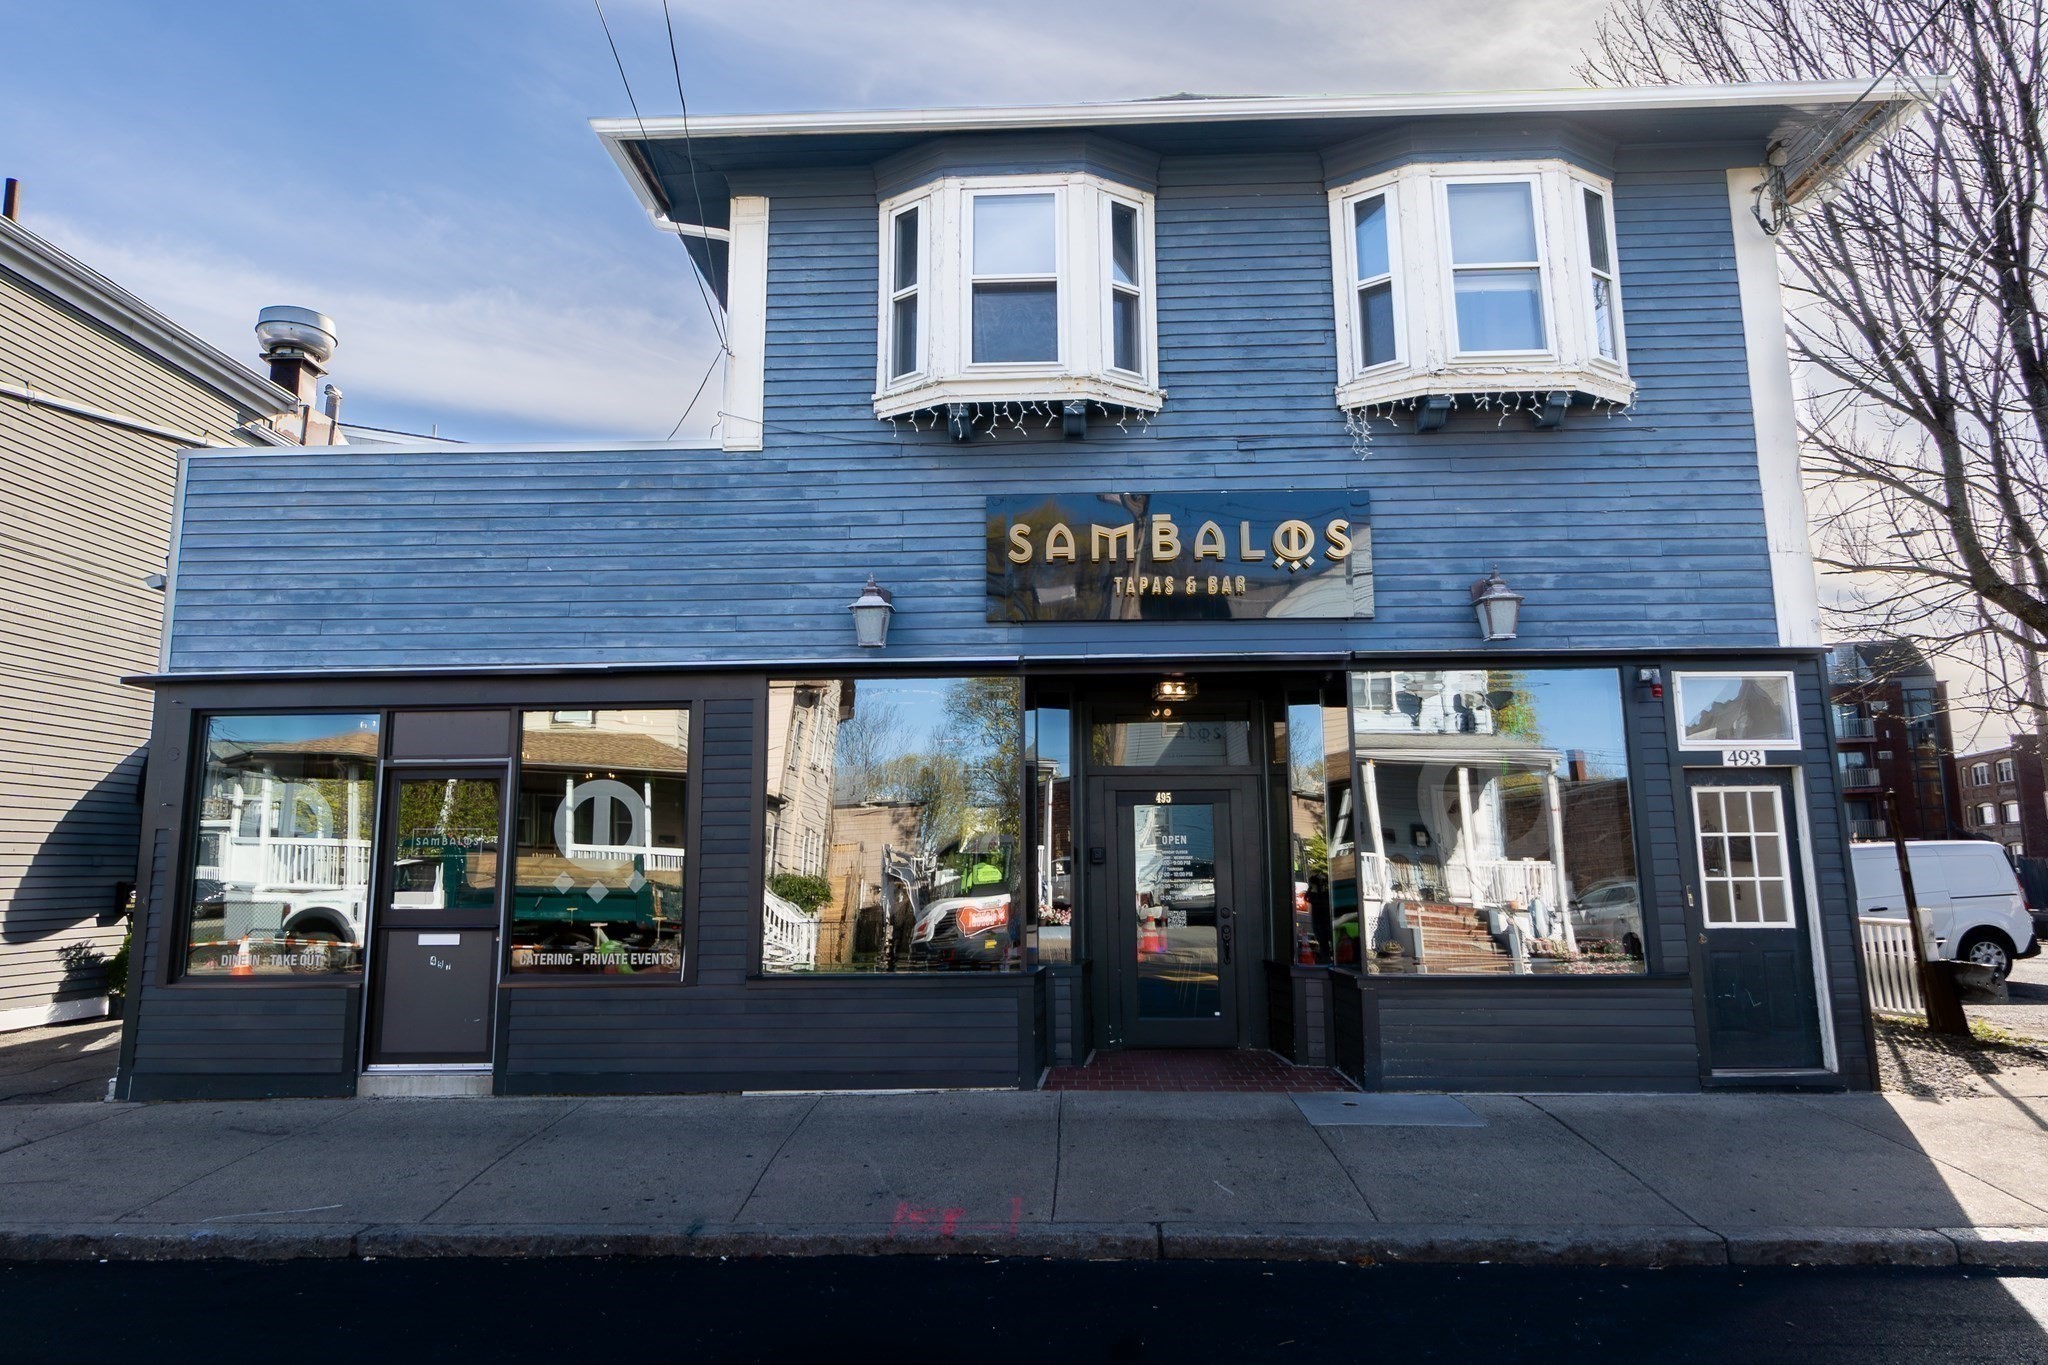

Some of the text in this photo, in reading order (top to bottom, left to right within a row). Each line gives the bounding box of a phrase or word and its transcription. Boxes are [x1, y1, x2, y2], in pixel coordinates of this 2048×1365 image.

[1114, 575, 1246, 596] TAPAS & BAR
[1727, 750, 1761, 766] 493
[1156, 792, 1172, 803] 495
[1162, 835, 1187, 845] OPEN
[270, 954, 297, 966] TAKE
[300, 954, 321, 966] OUT
[520, 953, 573, 965] CATERING
[583, 953, 628, 965] PRIVATE
[630, 953, 673, 965] EVENTS
